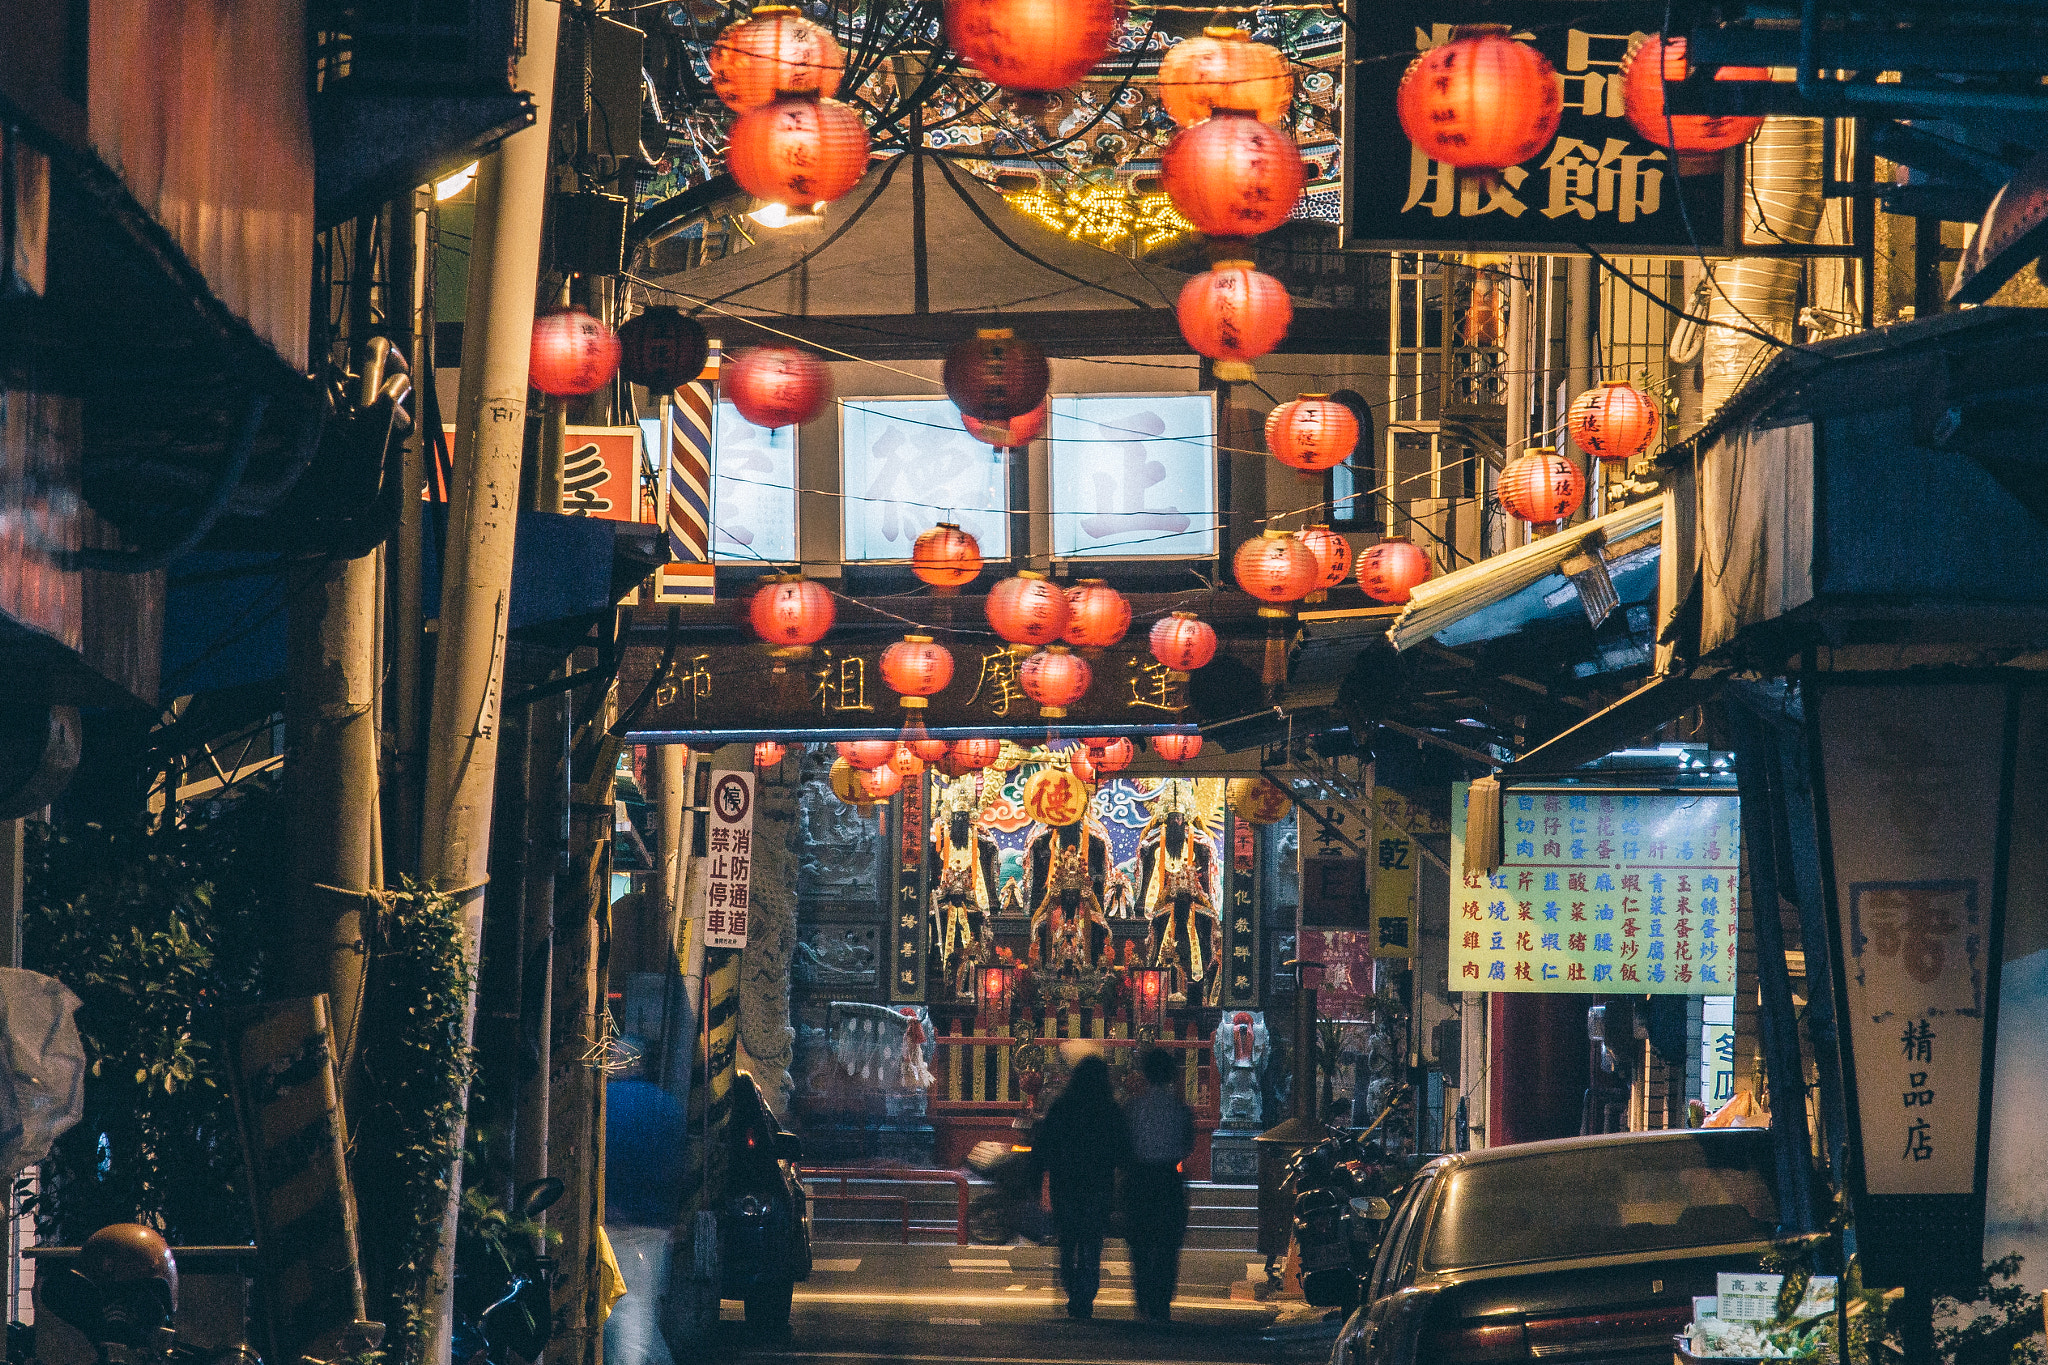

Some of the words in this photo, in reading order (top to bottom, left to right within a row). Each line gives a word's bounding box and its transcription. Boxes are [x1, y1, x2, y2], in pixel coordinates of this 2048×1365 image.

[1415, 23, 1650, 118] 品
[1401, 136, 1667, 223] 服飾
[1582, 396, 1606, 451] 正德堂
[1553, 461, 1573, 514] 正德堂
[723, 786, 741, 812] 停
[1031, 777, 1077, 822] 德
[707, 827, 729, 935] 禁止停車
[727, 828, 750, 936] 消防通道
[1462, 874, 1482, 980] 紅燒雞肉
[1488, 873, 1509, 981] 紅燒豆腐
[1514, 871, 1534, 981] 芹菜花枝
[1567, 872, 1589, 981] 酸菜豬肚
[1620, 874, 1642, 982] 蝦仁蛋炒飯
[1647, 873, 1667, 983] 青菜豆腐湯
[1674, 874, 1694, 983] 玉米蛋花湯
[1699, 874, 1720, 983] 肉絲蛋炒飯
[1901, 1019, 1936, 1162] 精品店
